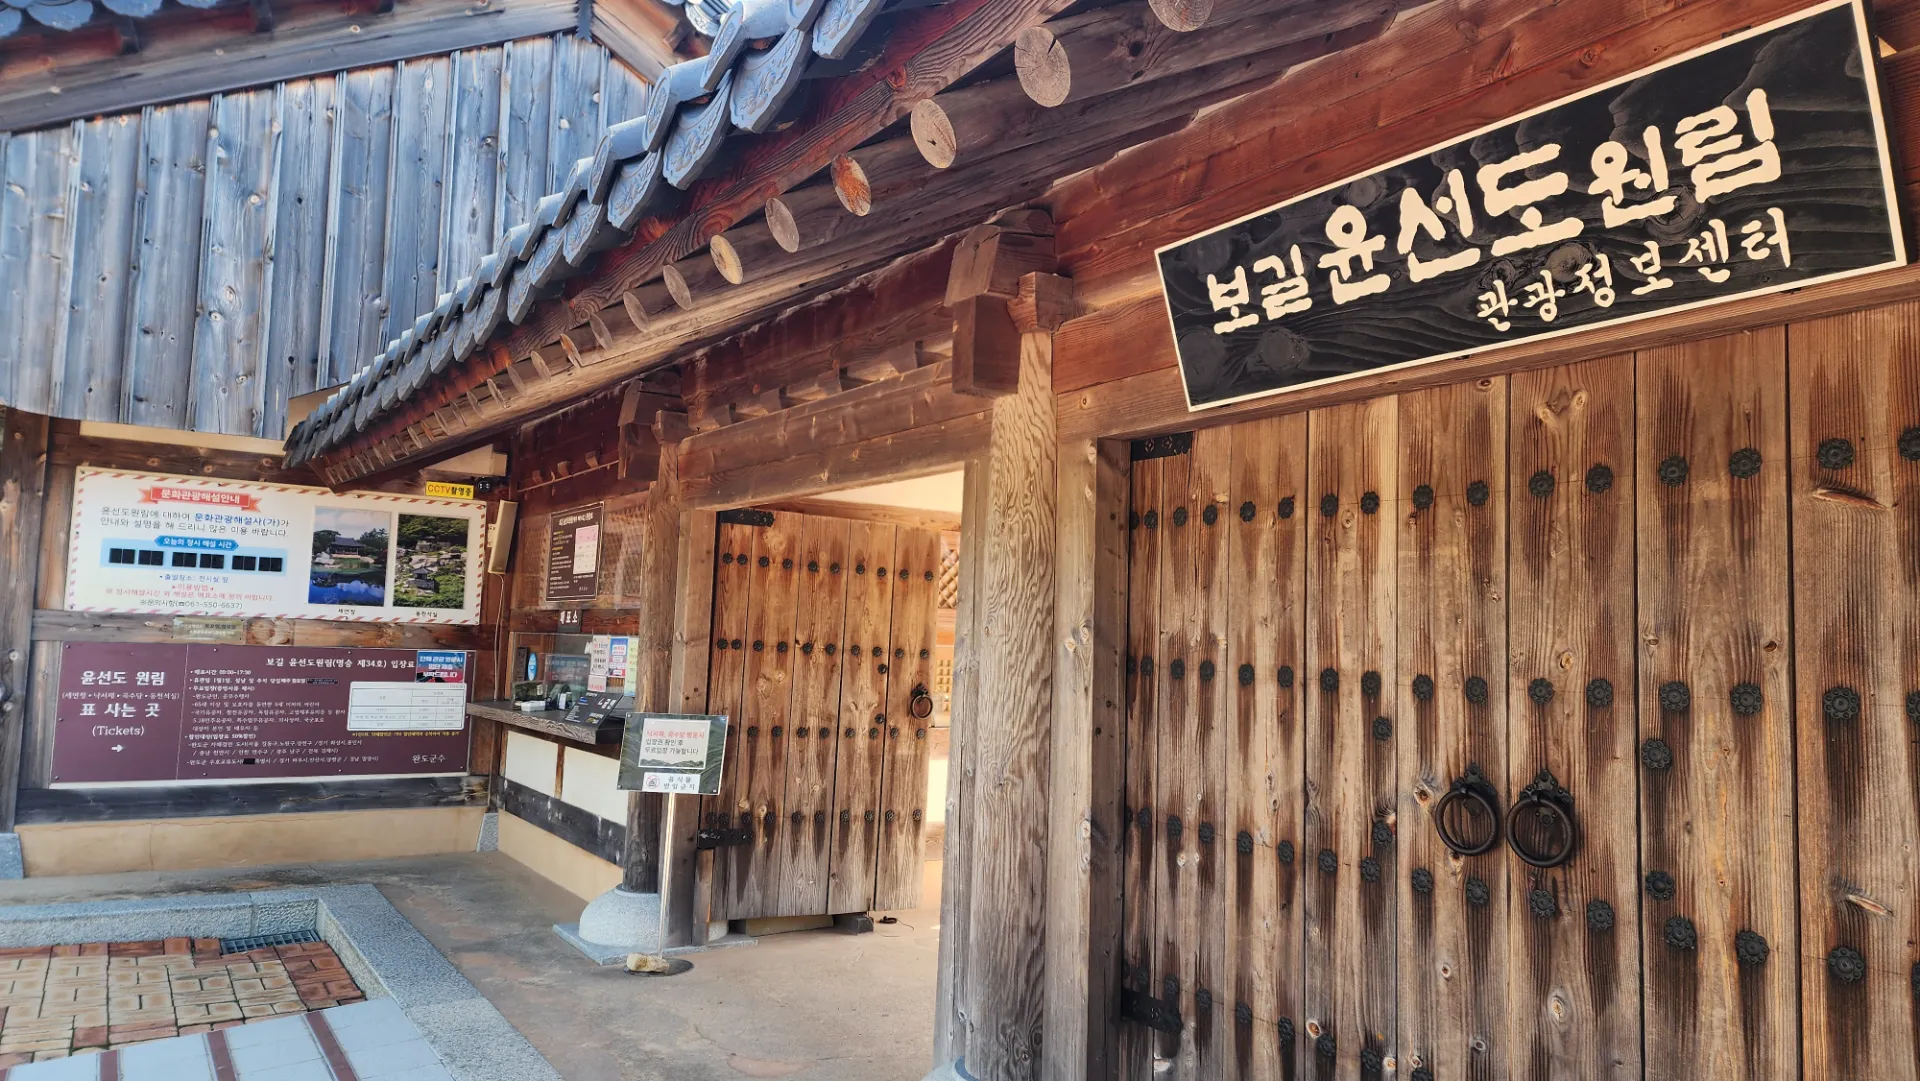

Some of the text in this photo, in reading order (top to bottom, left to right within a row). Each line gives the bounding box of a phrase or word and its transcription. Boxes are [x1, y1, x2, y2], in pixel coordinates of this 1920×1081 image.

[1477, 207, 1792, 332] 관광정보센터
[1207, 245, 1313, 333] 보길
[161, 488, 240, 504] 문화관광해설안내
[101, 506, 159, 519] 윤선도원림에
[163, 511, 190, 521] 대하여
[101, 517, 128, 528] 안내와
[134, 520, 160, 530] 설명을
[166, 521, 174, 530] 해
[178, 522, 206, 531] 드리니
[231, 526, 248, 536] 이용
[163, 537, 184, 546] 오늘의
[218, 540, 232, 549] 시간
[266, 657, 284, 667] 보길
[356, 659, 387, 669] 제34호)
[390, 660, 415, 669] 입장료
[80, 670, 165, 687] 윤선도 원림
[79, 703, 160, 718] 표 사는 곳
[92, 725, 145, 737] (Tickets)
[412, 754, 446, 763] 완도군수
